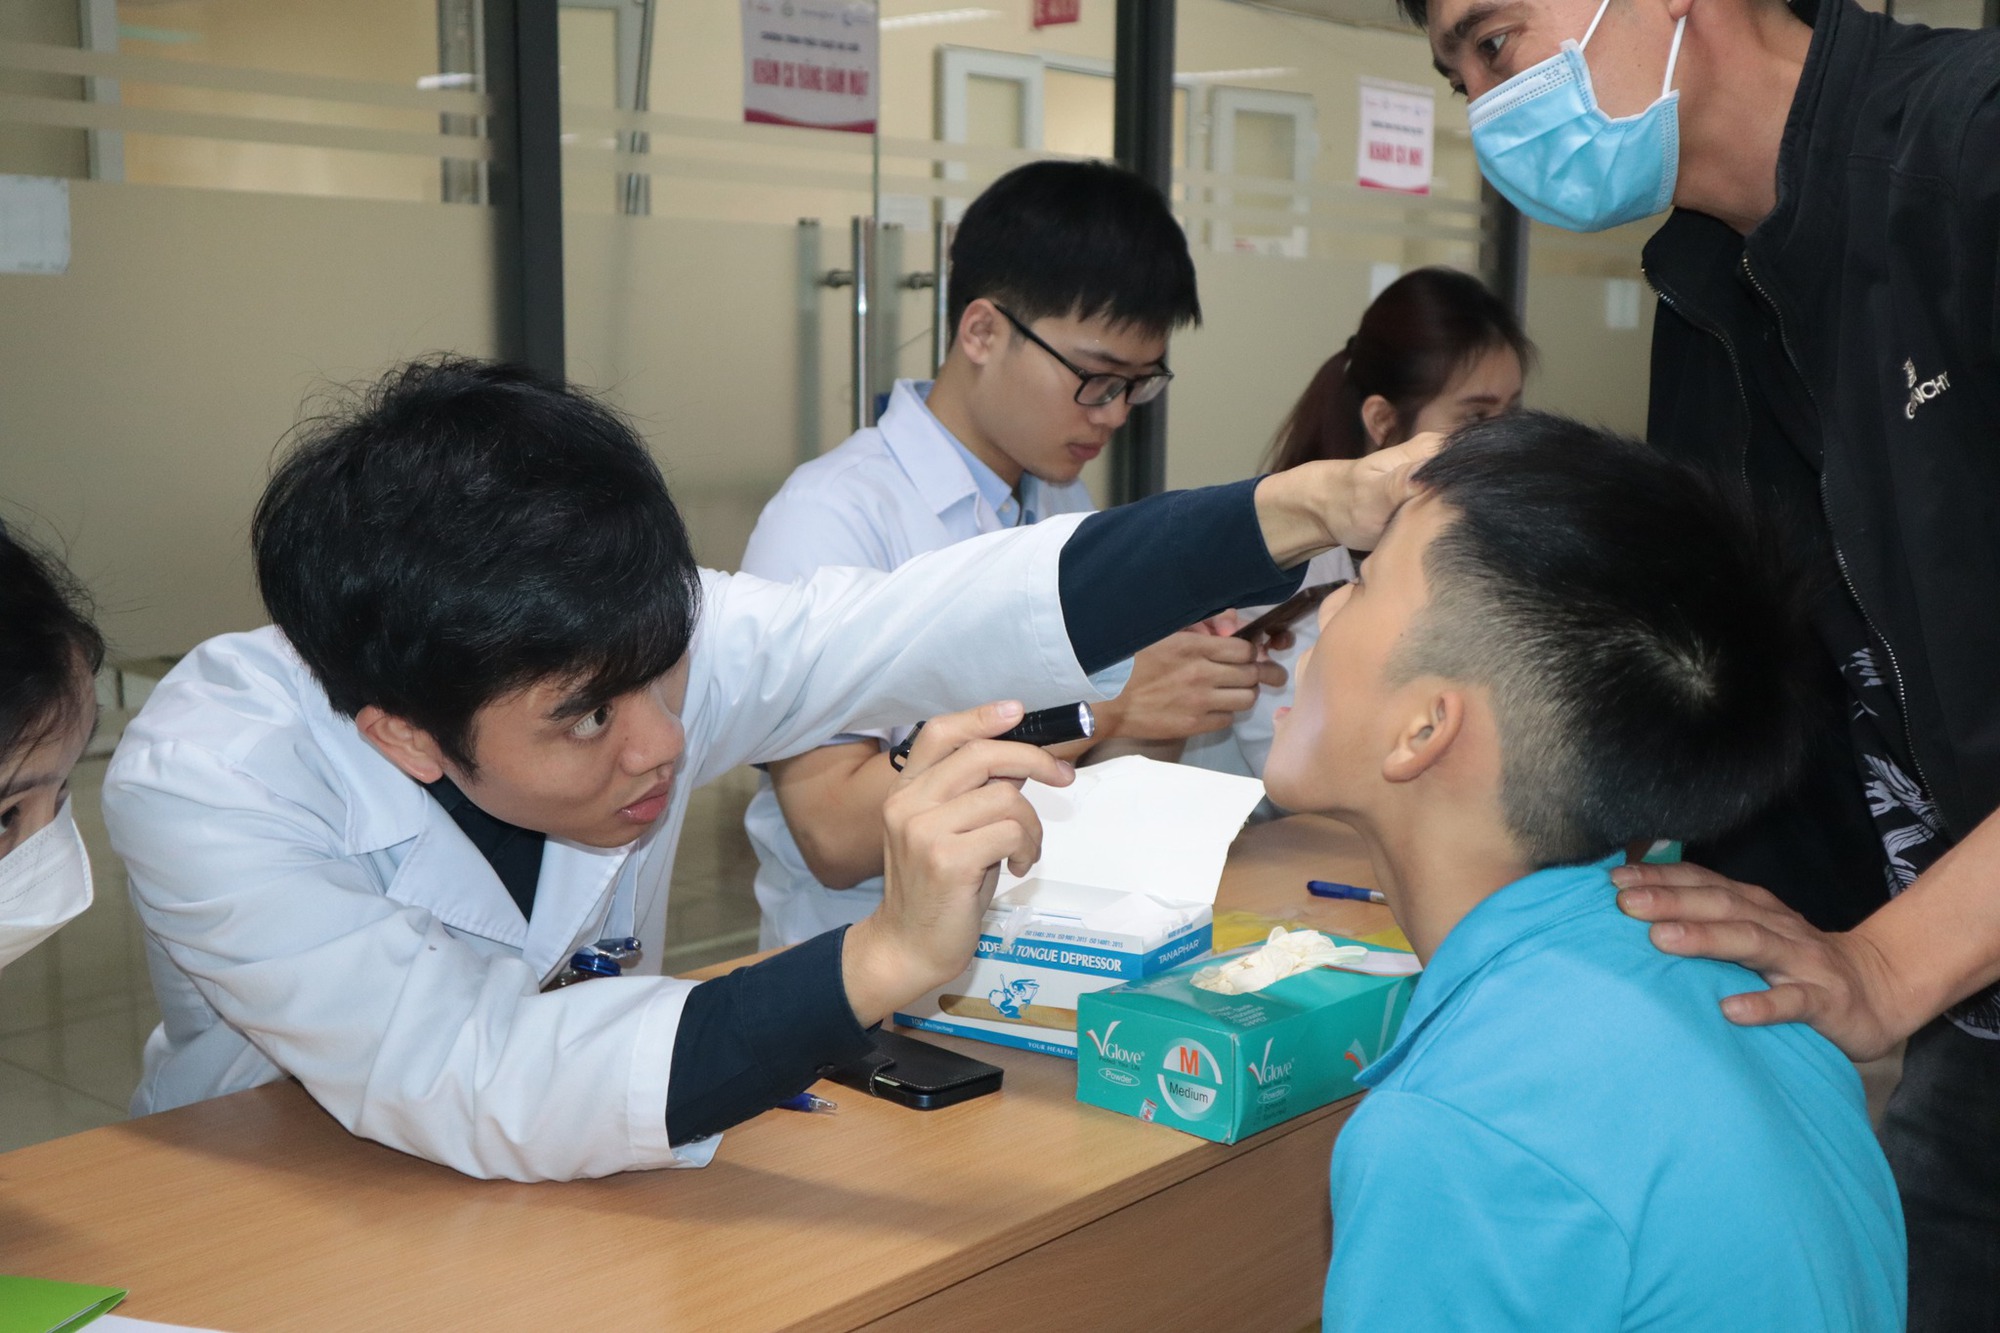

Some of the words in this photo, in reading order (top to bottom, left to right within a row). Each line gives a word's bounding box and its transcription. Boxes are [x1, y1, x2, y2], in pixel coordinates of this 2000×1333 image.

[1016, 945, 1059, 963] TONGUE
[1060, 950, 1122, 972] DEPRESSOR
[1158, 939, 1199, 964] TANAPHAR
[1028, 1042, 1046, 1050] YOUR
[1180, 1046, 1199, 1077] M
[1105, 1069, 1133, 1084] Powder
[1169, 1081, 1209, 1104] Medium
